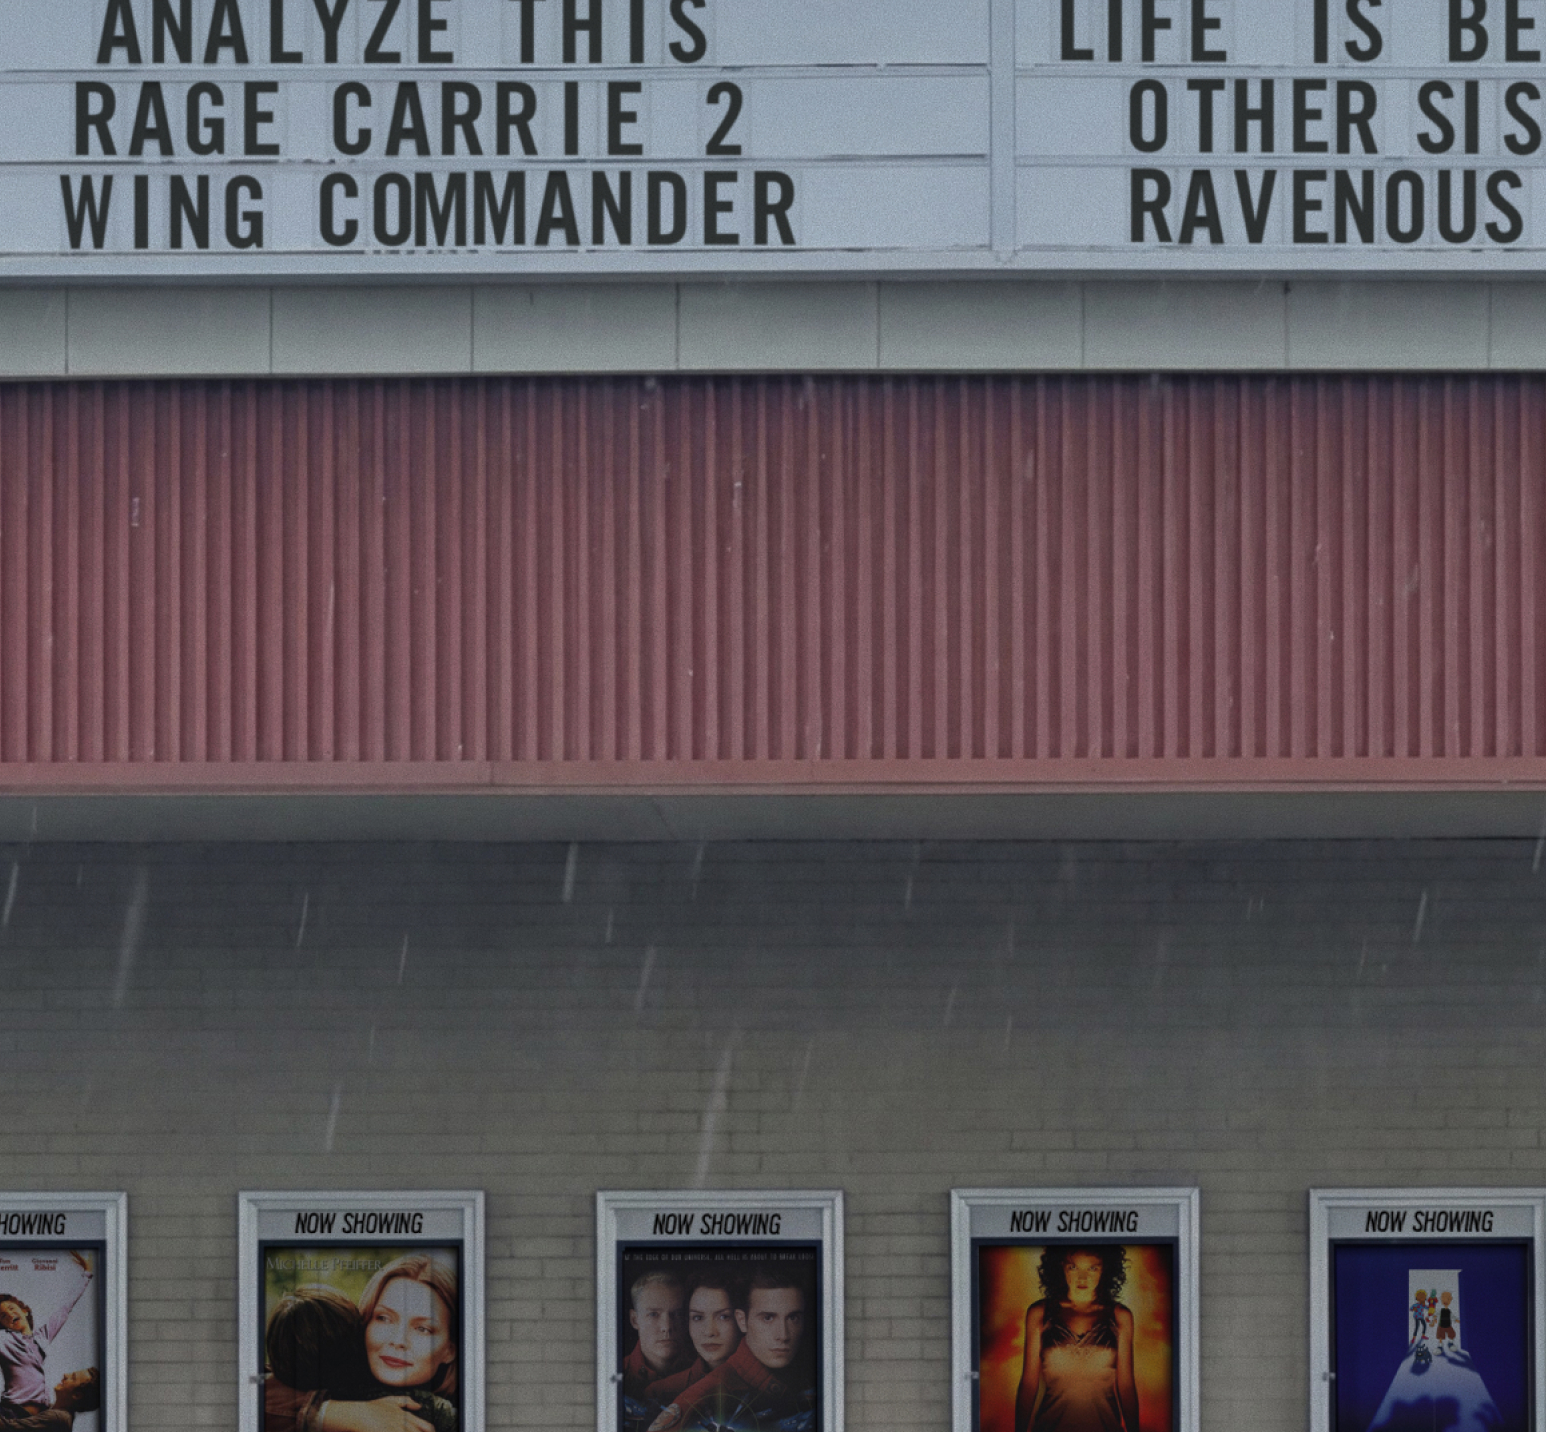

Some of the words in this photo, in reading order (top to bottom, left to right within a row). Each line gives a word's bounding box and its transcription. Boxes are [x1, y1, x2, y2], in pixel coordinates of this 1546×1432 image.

[95, 0, 455, 65] ANALYZE
[510, 0, 709, 65] THIS
[1059, 0, 1229, 63] LIFE
[1311, 0, 1384, 63] IS
[73, 80, 282, 157] RAGE
[332, 80, 644, 157] CARRIE
[704, 80, 746, 157] 2
[1127, 78, 1380, 157] OTHER
[59, 170, 266, 249] WING
[318, 170, 798, 249] COMMANDER
[1128, 167, 1525, 245] RAVENOUS
[294, 1212, 336, 1234] NOW
[341, 1212, 424, 1234] SHOWING
[653, 1213, 695, 1235] NOW
[700, 1213, 782, 1235] SHOWING
[1009, 1211, 1051, 1233] NOW
[1057, 1211, 1139, 1233] SHOWING
[1365, 1211, 1407, 1233] NOW
[1412, 1211, 1494, 1233] SHOWING
